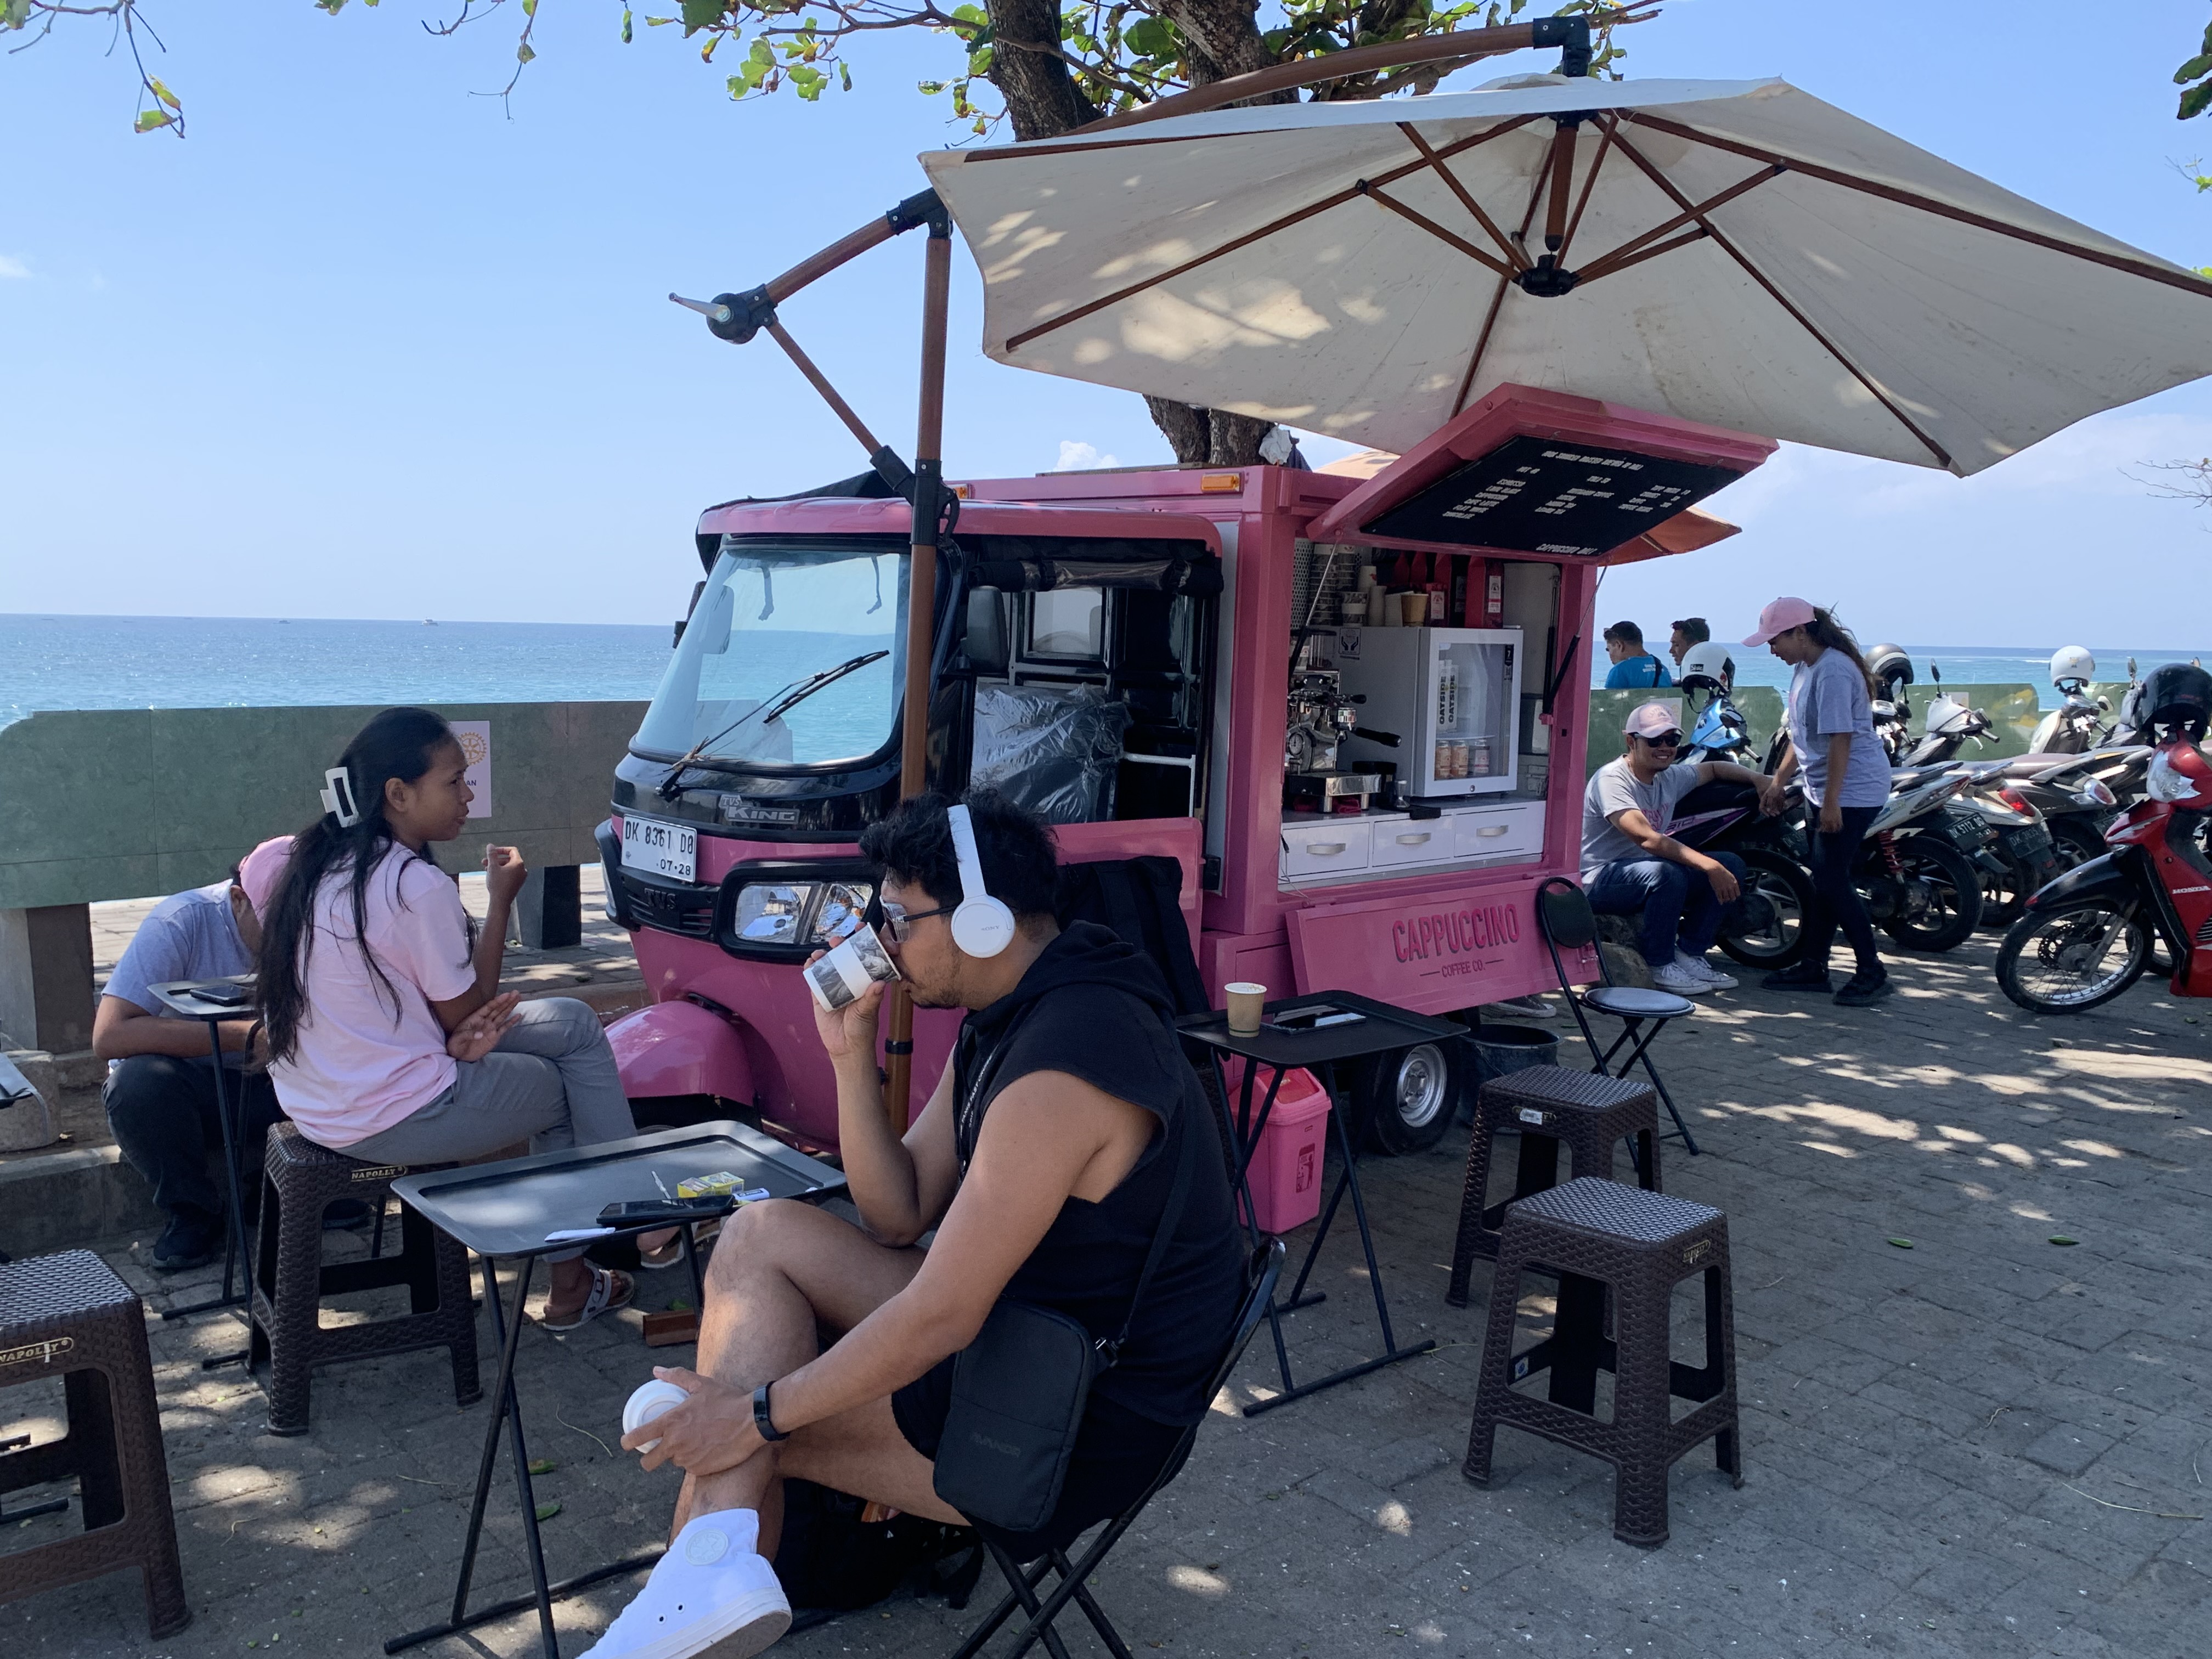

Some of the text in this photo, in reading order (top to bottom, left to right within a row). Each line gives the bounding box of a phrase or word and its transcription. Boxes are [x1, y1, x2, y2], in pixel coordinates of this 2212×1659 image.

[723, 797, 740, 806] TVS
[728, 806, 795, 821] KING
[625, 821, 639, 842] DK
[645, 826, 671, 849] 8361
[2172, 885, 2211, 894] HONDA
[644, 888, 676, 910] TVS
[1392, 903, 1520, 963] CAPPUCCINO
[1442, 960, 1486, 977] COFFEE CO.
[352, 1169, 395, 1180] NAPOLLY
